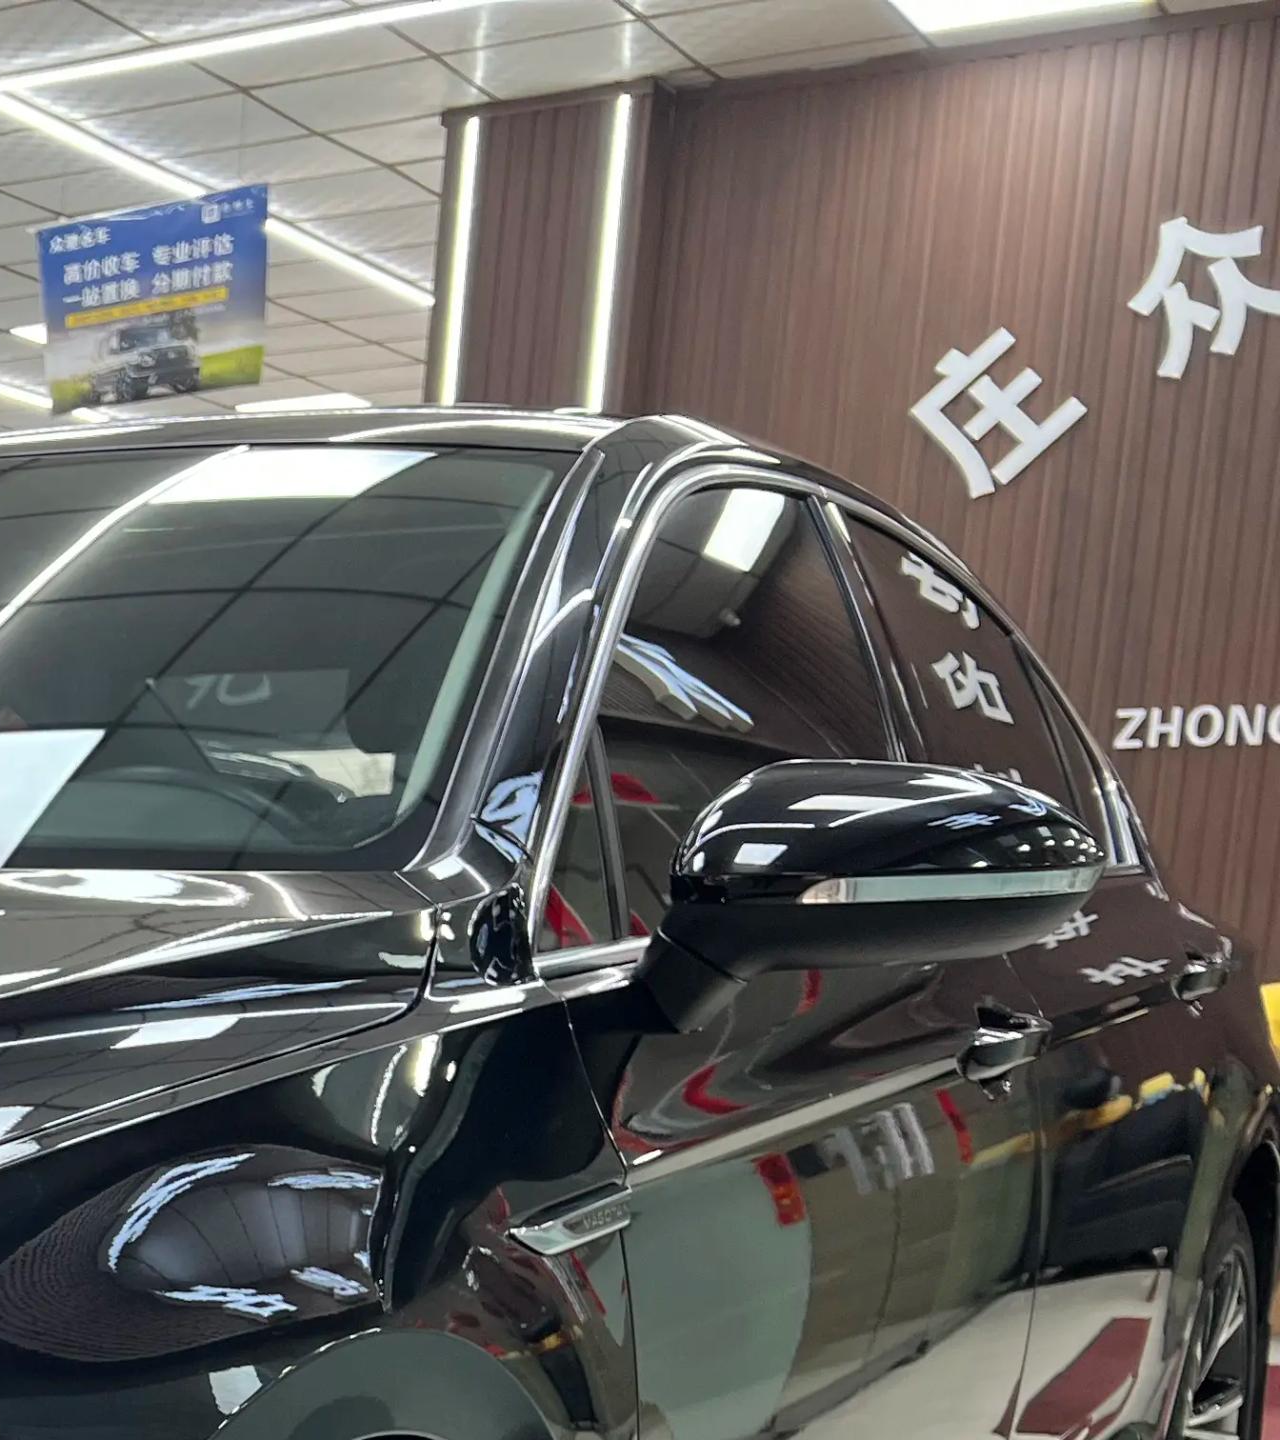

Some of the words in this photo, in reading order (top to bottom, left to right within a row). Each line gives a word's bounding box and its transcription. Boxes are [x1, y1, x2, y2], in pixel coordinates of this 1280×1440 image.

[63, 251, 140, 285] 高价收车
[151, 232, 235, 266] 专业评估
[62, 278, 140, 308] 一站置换
[152, 260, 234, 295] 分期付款
